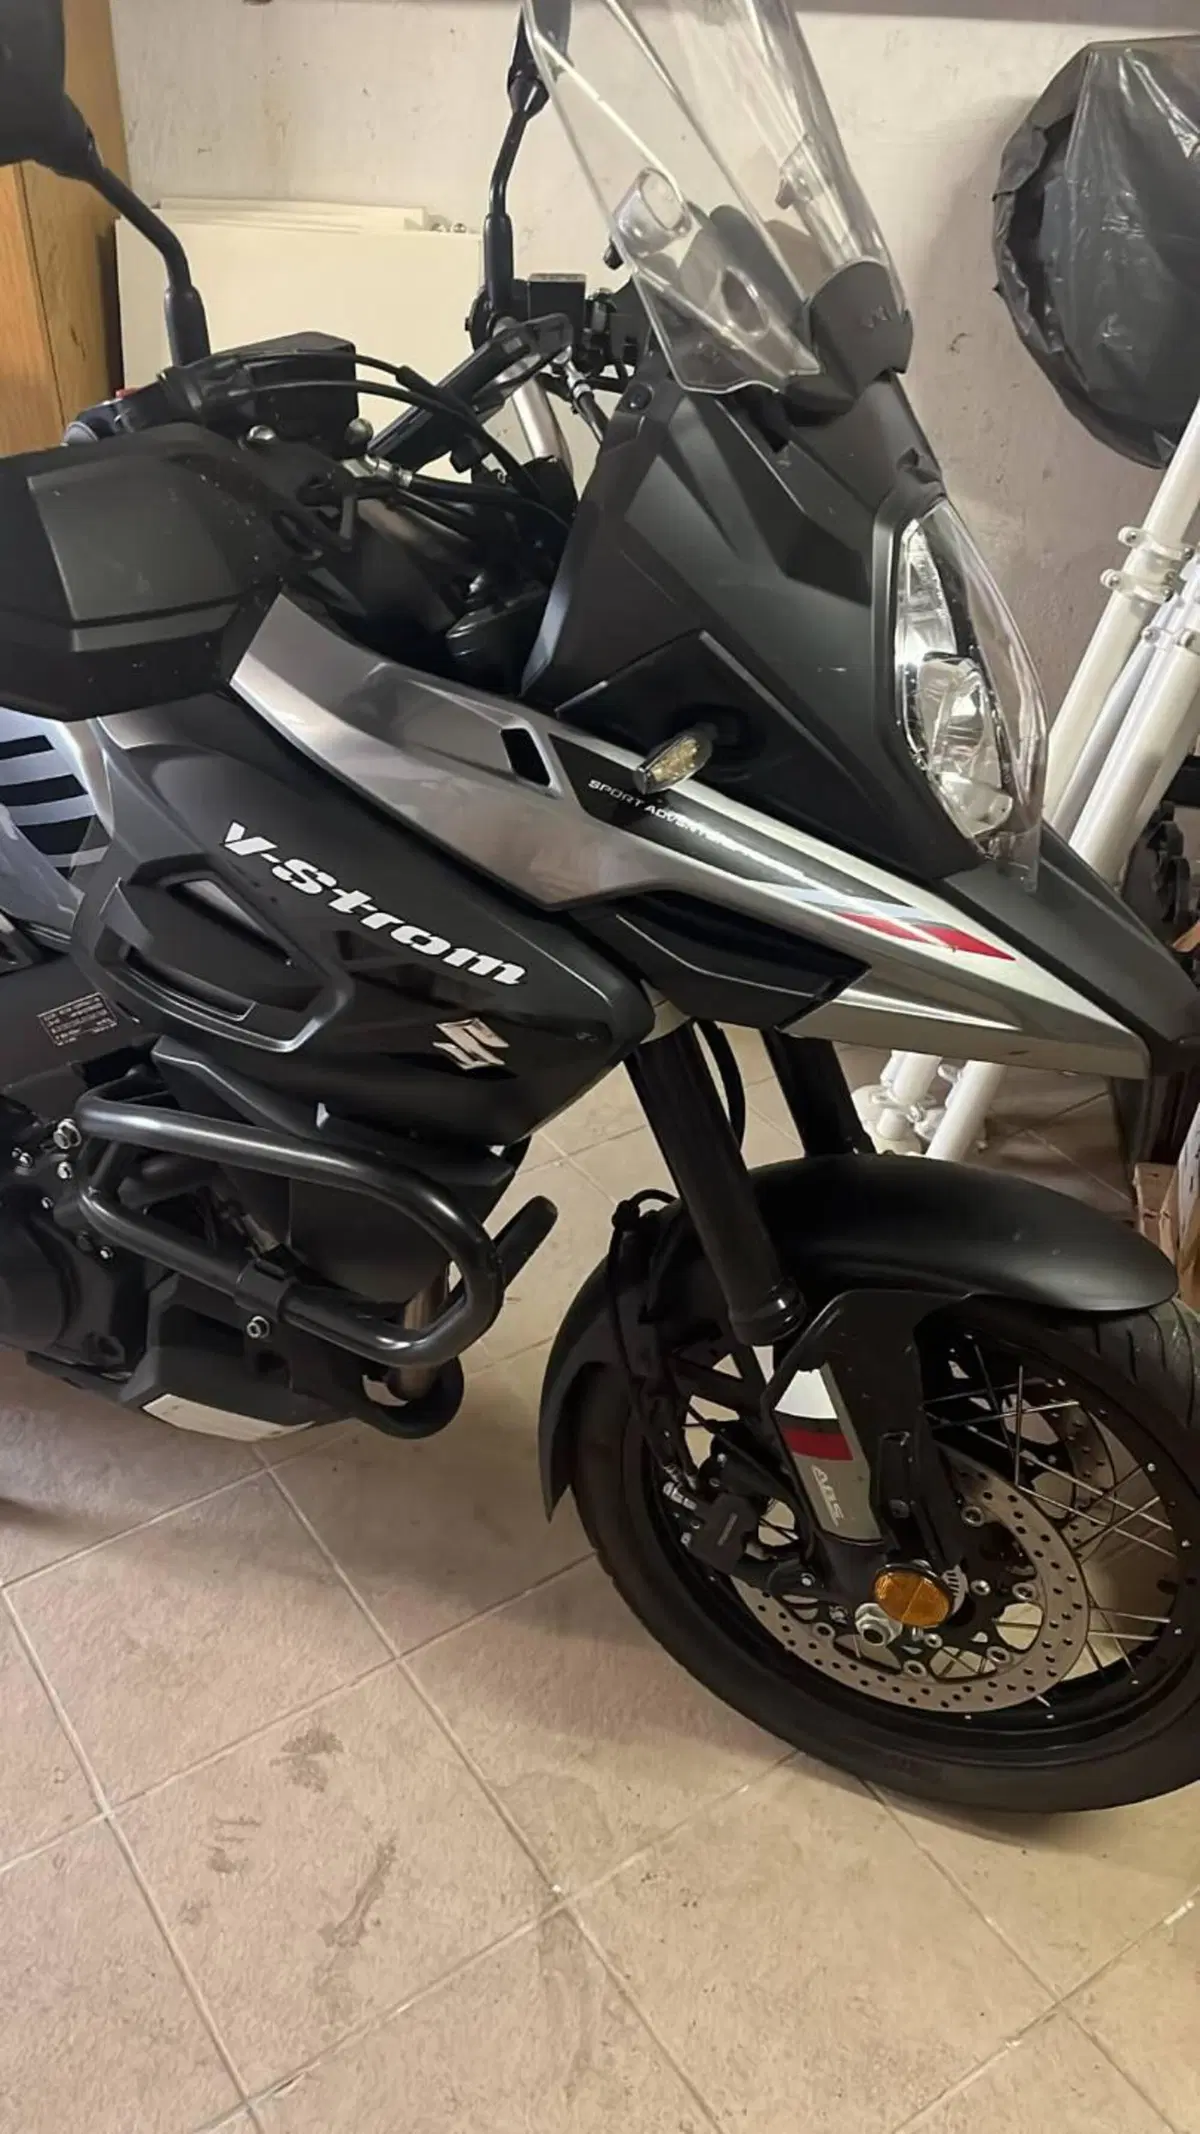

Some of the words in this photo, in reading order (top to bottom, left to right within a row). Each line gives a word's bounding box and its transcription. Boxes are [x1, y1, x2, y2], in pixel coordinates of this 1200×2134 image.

[588, 779, 644, 807] SPORT
[224, 821, 527, 985] V-Strom
[810, 1464, 845, 1528] ABS
